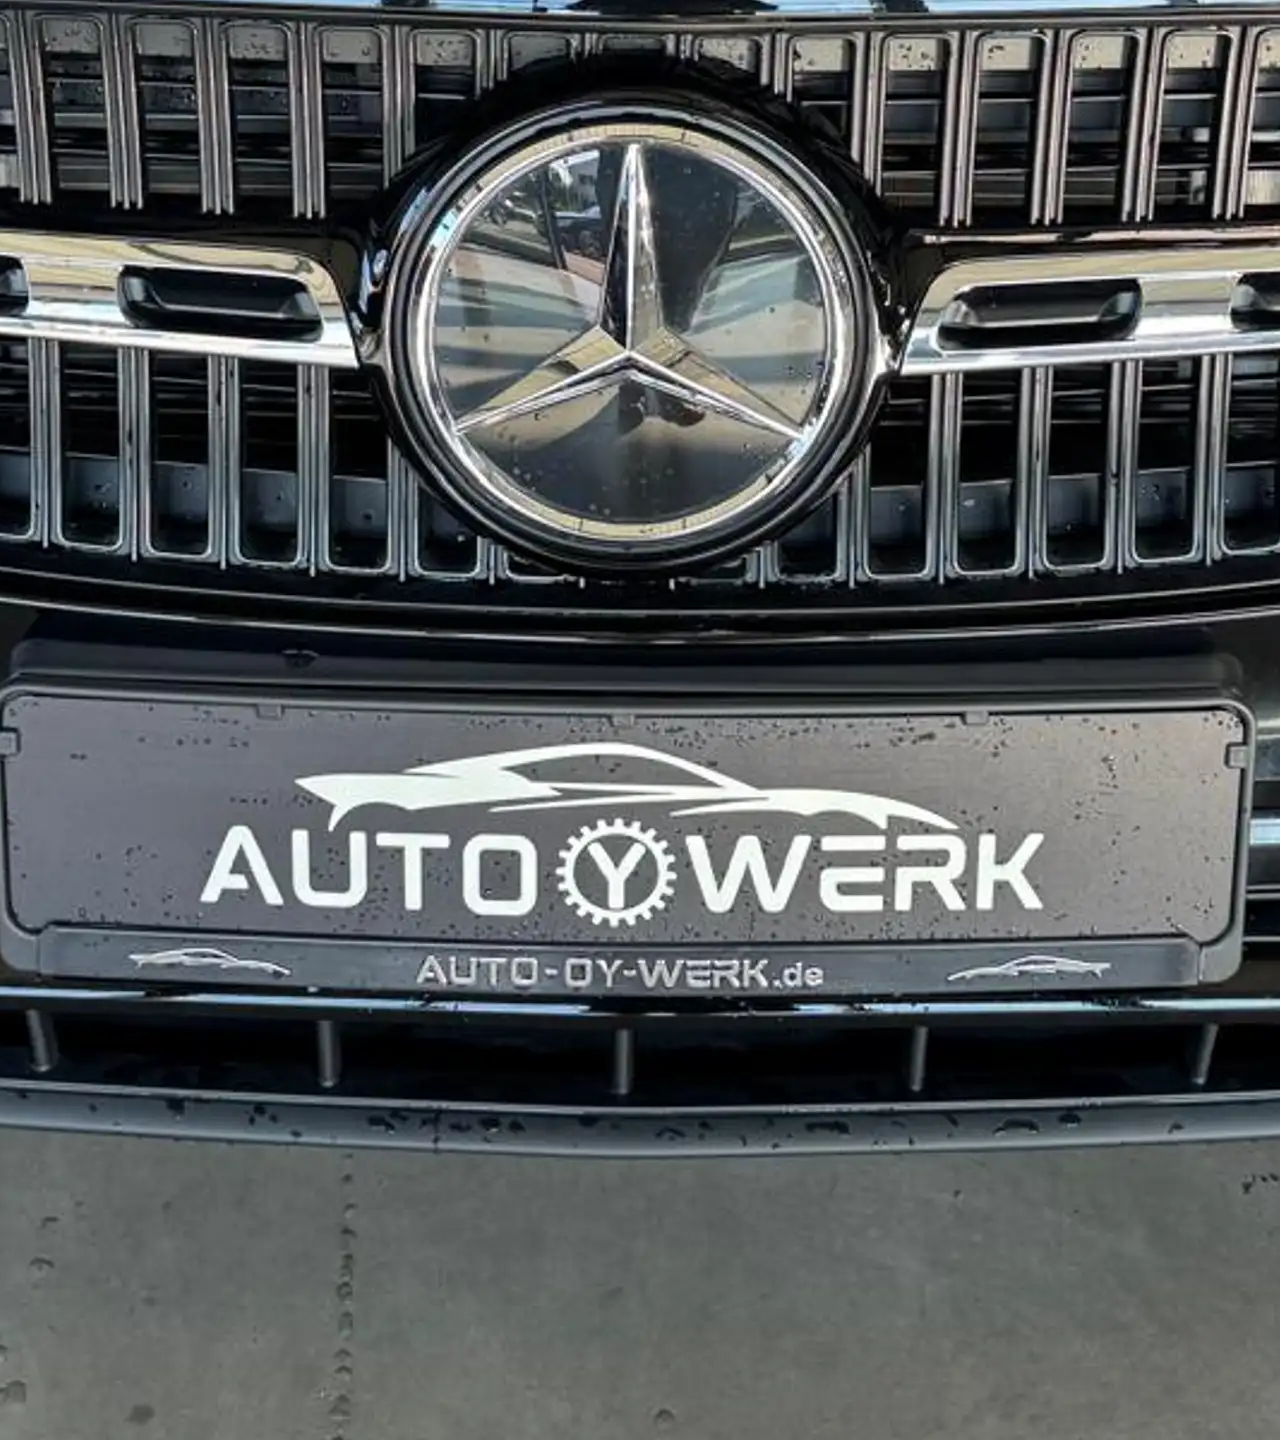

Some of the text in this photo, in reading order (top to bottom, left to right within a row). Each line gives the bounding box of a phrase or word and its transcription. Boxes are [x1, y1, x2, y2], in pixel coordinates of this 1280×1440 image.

[200, 824, 538, 916] AUTO
[686, 833, 1044, 912] WERK
[415, 954, 824, 989] AUTO-OY-WERK.de
